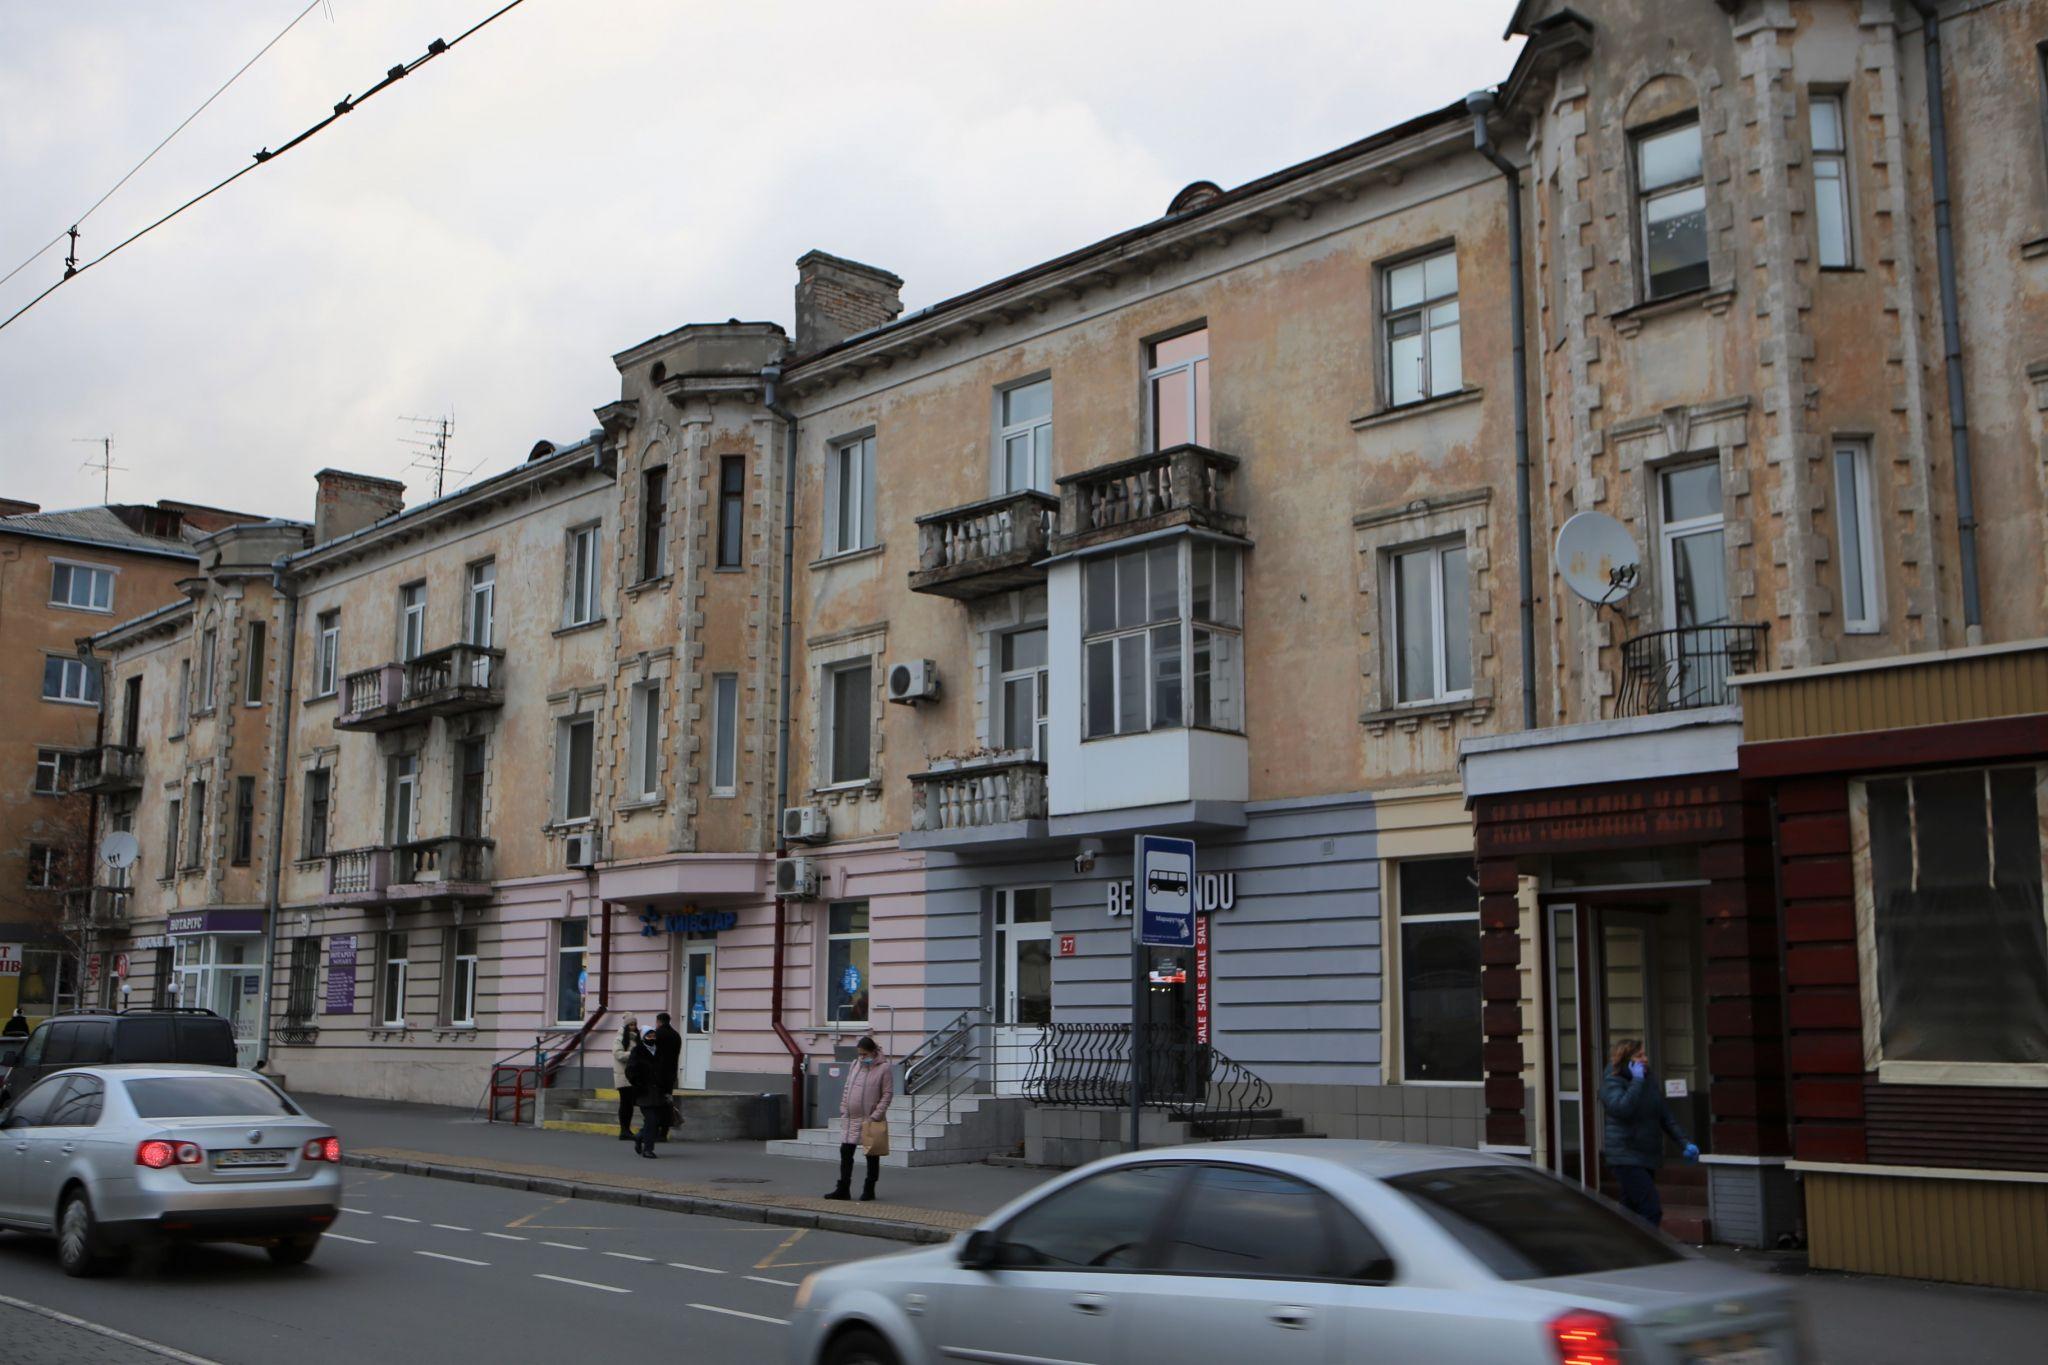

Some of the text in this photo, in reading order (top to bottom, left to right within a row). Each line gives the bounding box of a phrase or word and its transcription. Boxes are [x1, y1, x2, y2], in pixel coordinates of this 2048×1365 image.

[1062, 939, 1074, 952] 27
[1196, 916, 1208, 1045] SALE SALE SALE SALE
